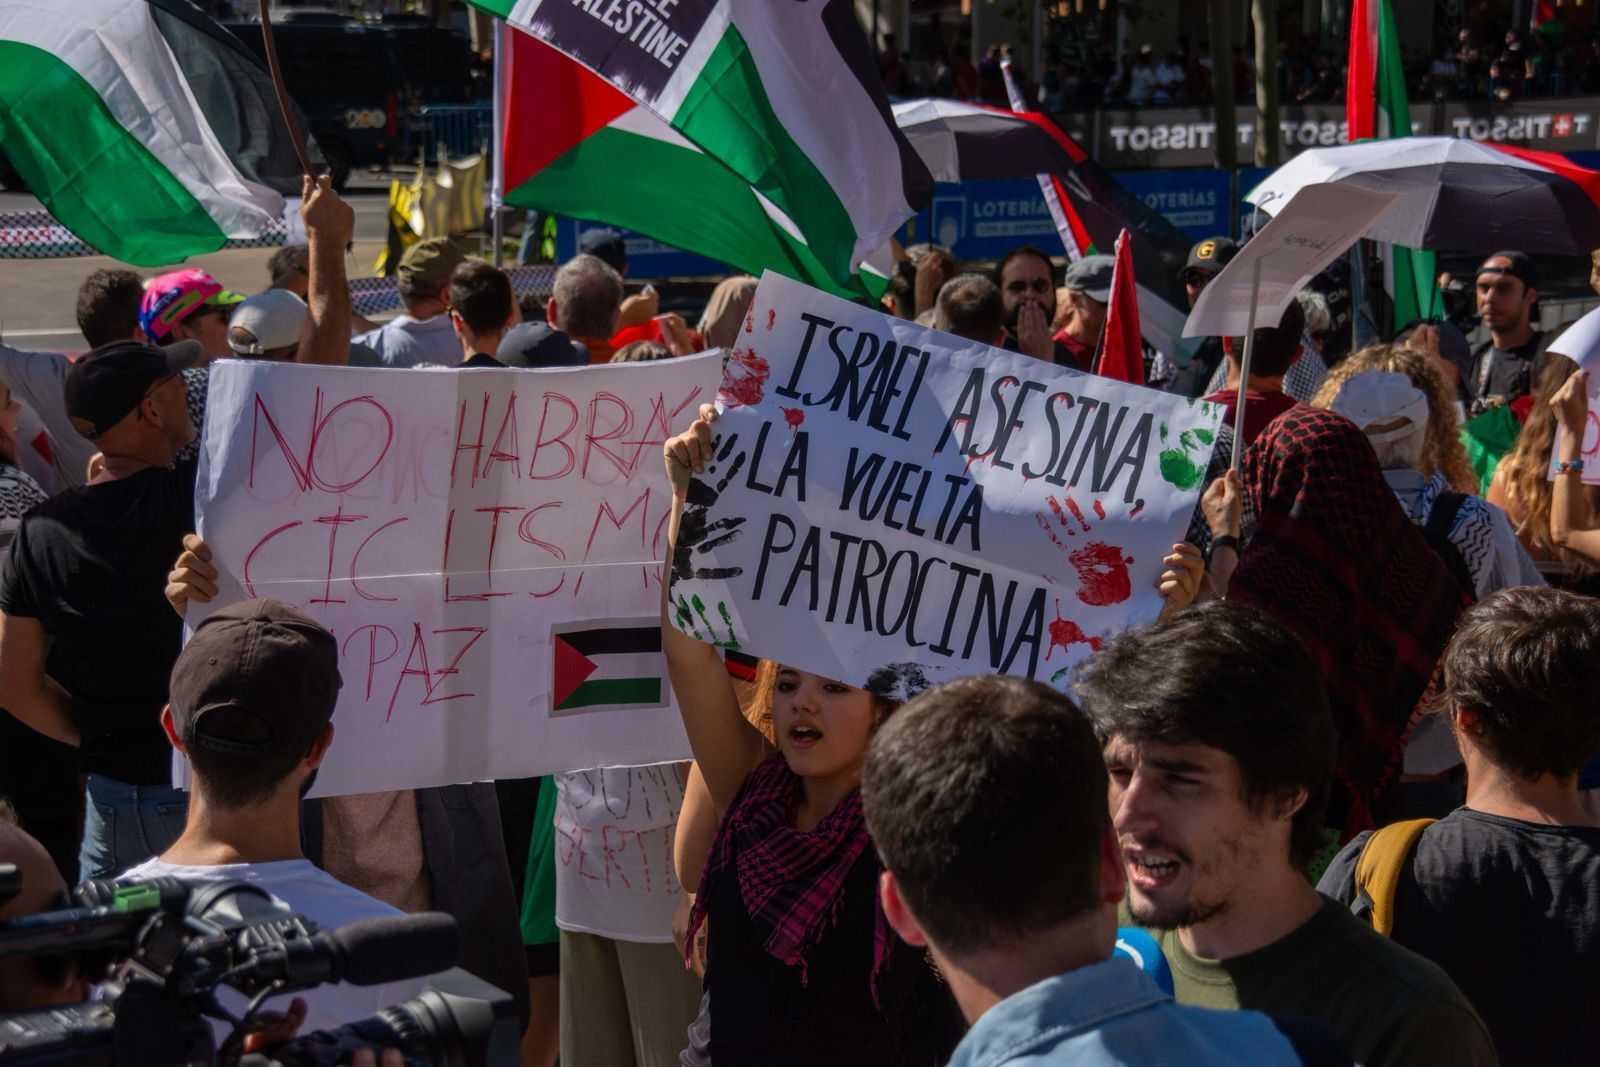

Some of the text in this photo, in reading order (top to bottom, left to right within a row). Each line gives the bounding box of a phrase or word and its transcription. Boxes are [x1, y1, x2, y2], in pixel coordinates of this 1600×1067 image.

[974, 197, 1050, 218] LOTERÍA
[1142, 189, 1215, 209] OTERÍAS
[775, 312, 931, 442] ISRAEL
[249, 386, 394, 493] NO
[746, 421, 984, 551] LA VUELTA
[751, 513, 1048, 679] PATROCINA
[342, 622, 488, 723] PAZ
